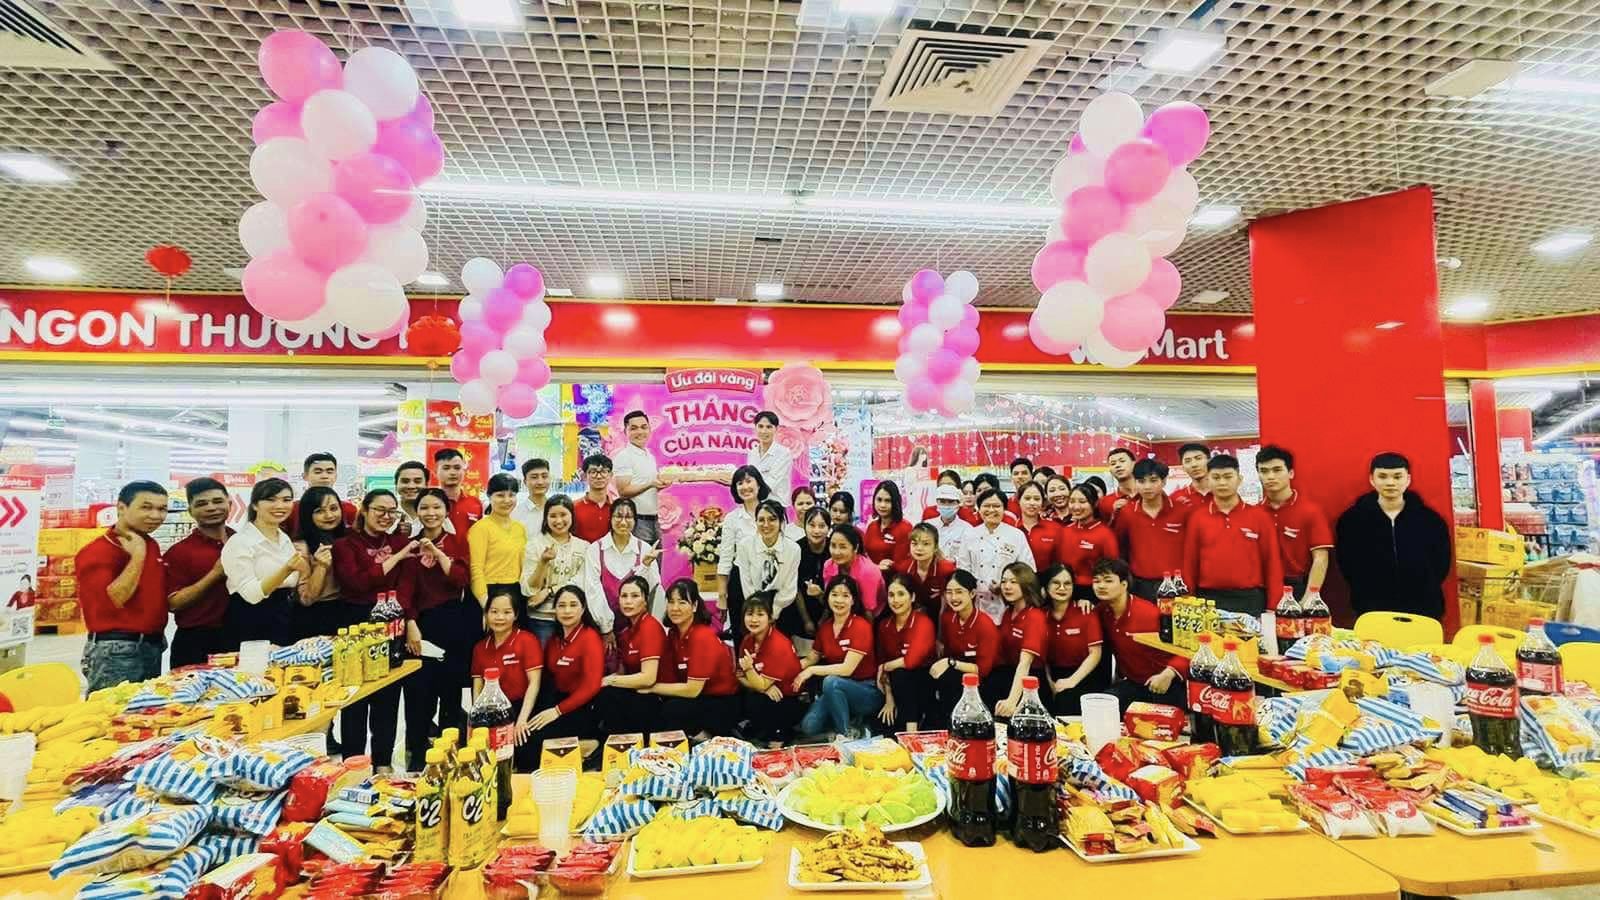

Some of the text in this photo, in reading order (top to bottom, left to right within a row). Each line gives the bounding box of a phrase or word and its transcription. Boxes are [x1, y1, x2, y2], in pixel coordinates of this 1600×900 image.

[671, 372, 692, 388] Ưu
[719, 371, 755, 390] vàng
[665, 399, 757, 425] THÁNG
[664, 433, 704, 454] CỦA
[419, 798, 441, 826] C2
